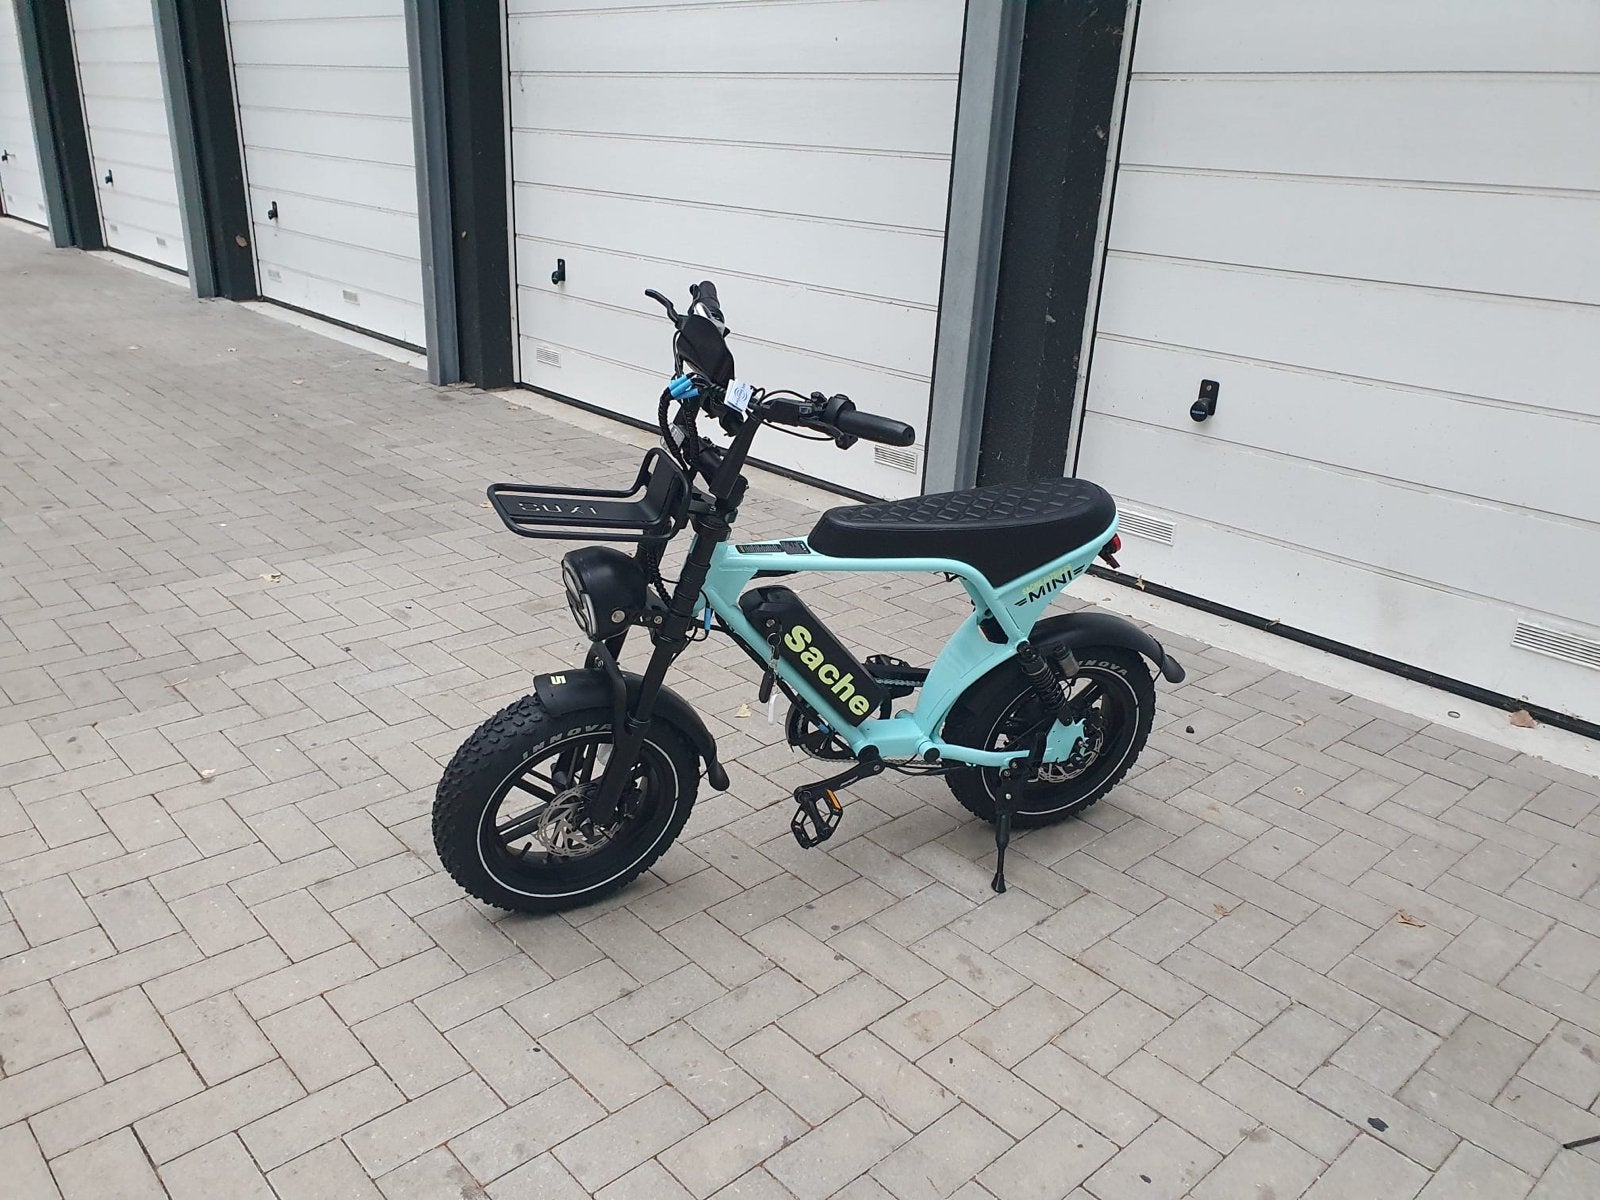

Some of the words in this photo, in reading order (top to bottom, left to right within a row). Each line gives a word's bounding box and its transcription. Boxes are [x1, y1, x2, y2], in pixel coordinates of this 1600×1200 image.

[1028, 570, 1073, 602] MINI
[784, 625, 870, 716] Sache
[523, 723, 612, 760] INNOVA
